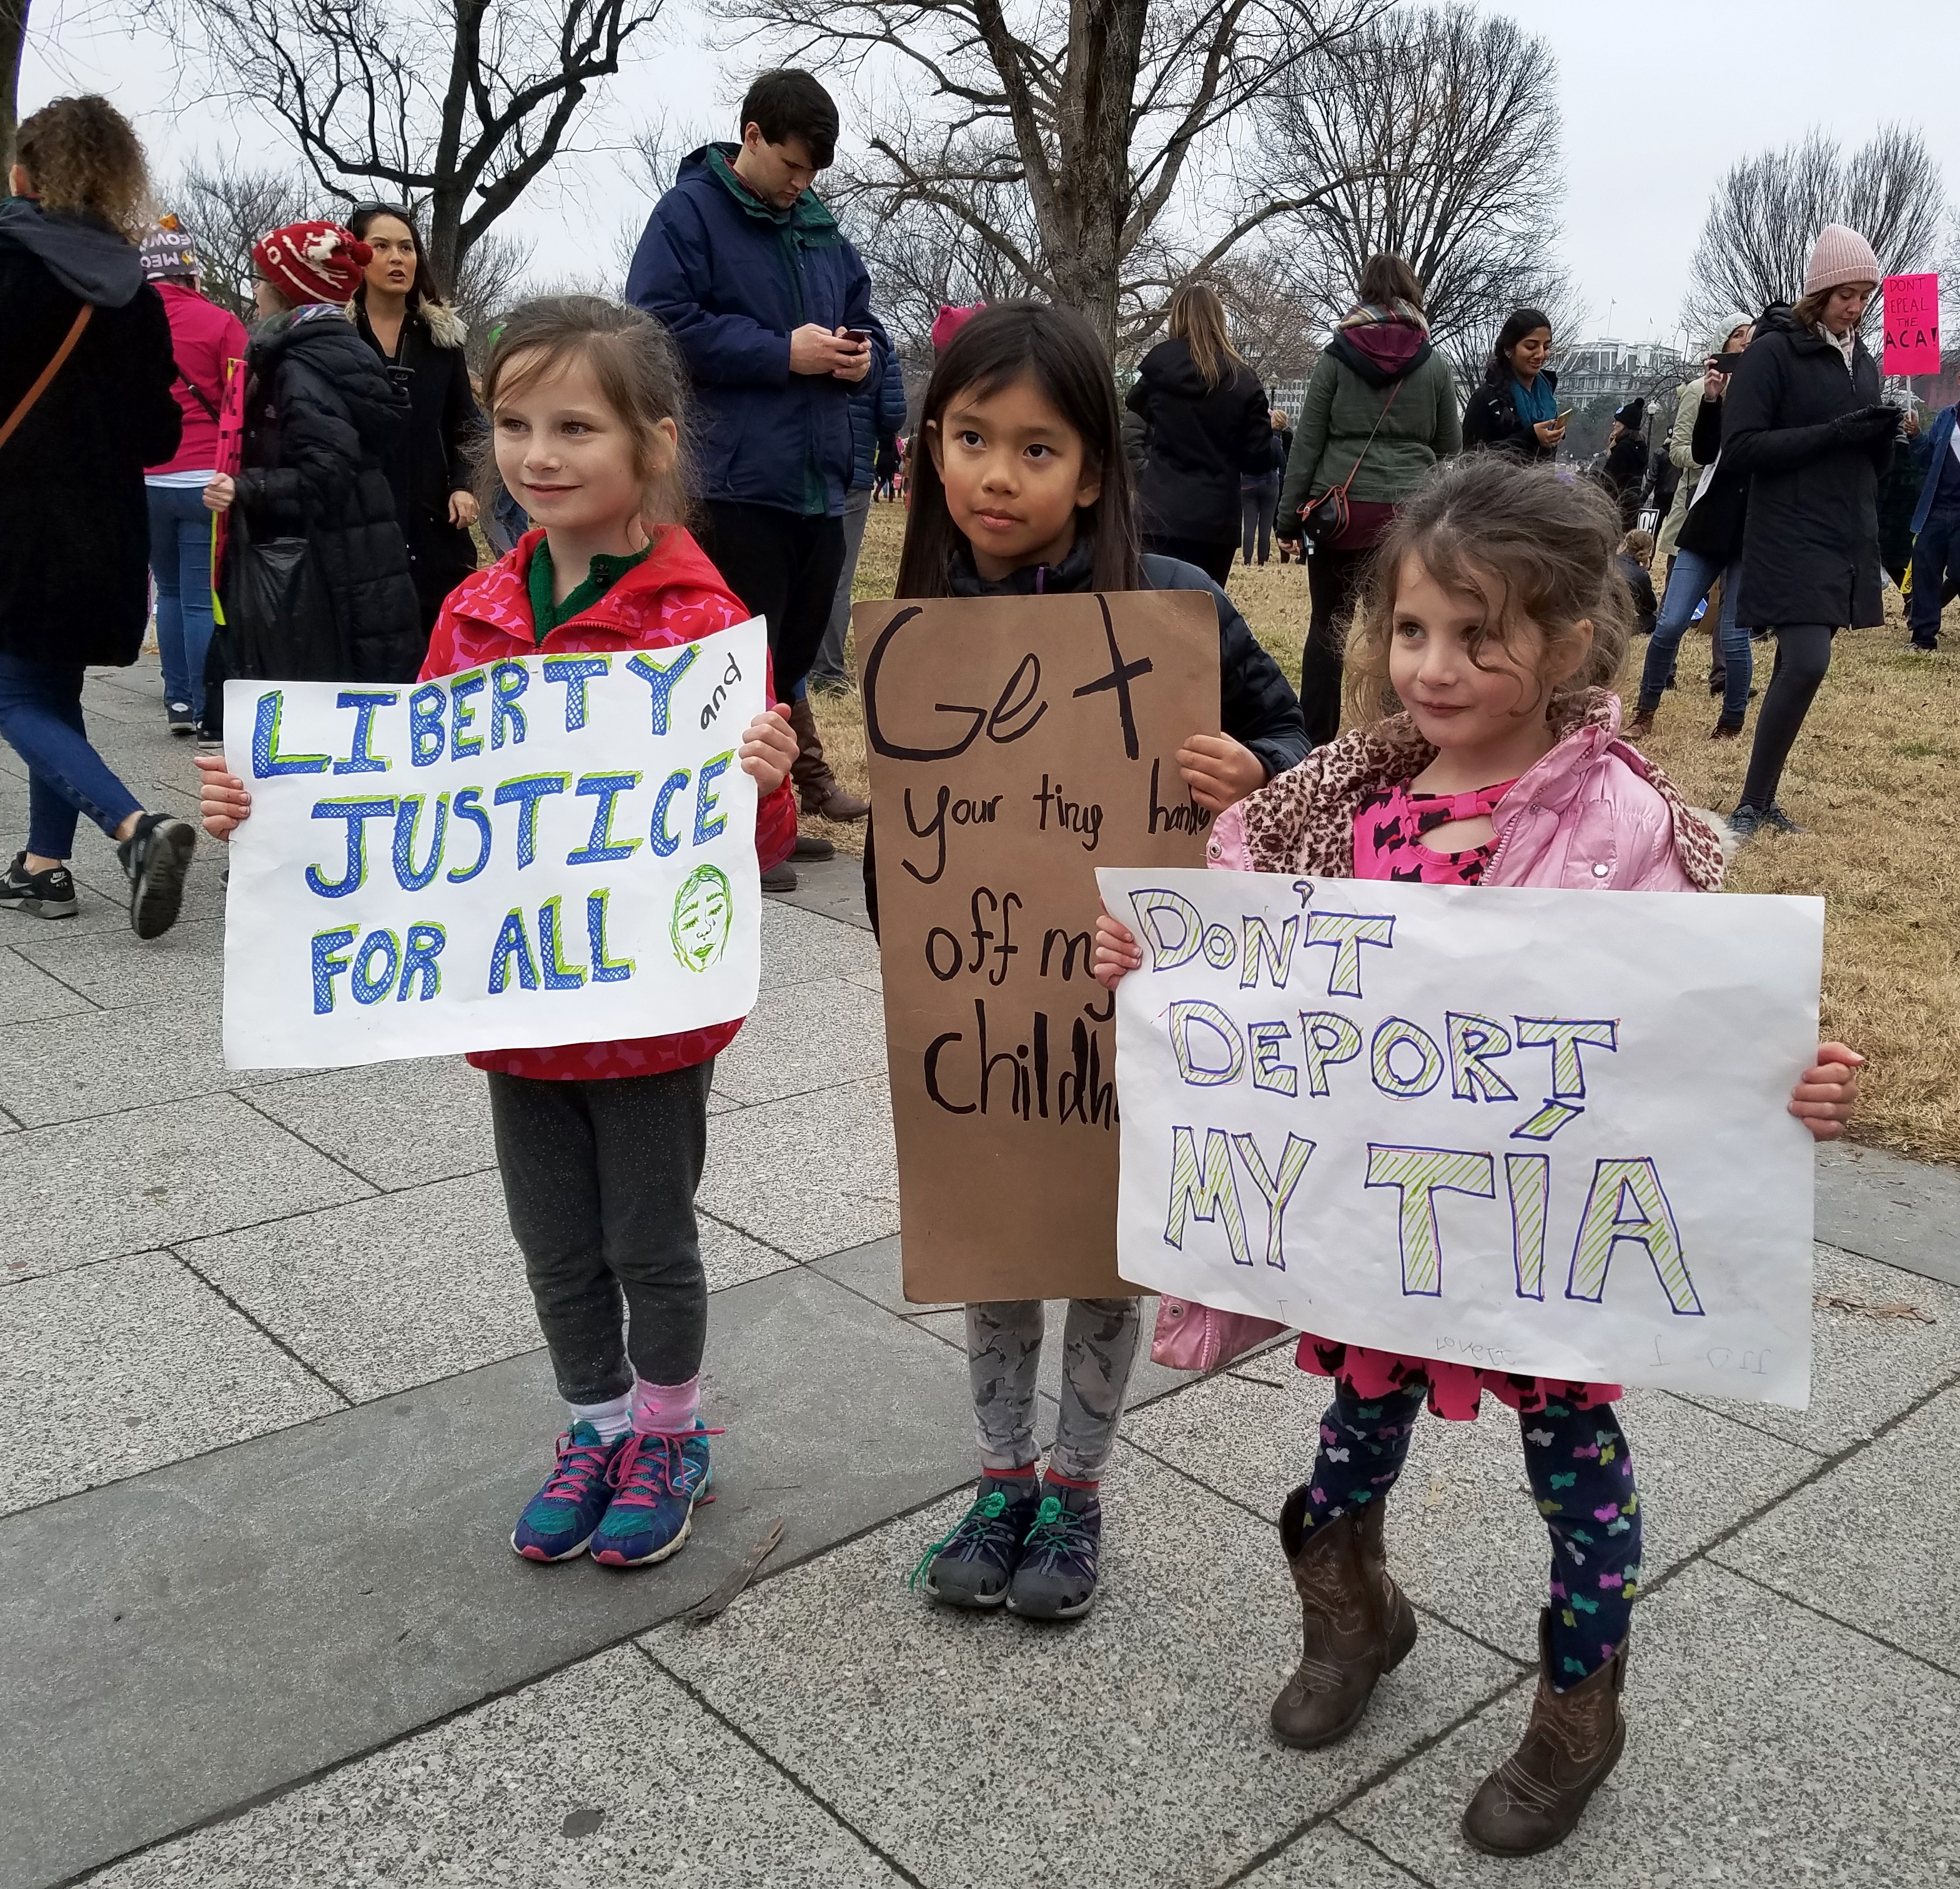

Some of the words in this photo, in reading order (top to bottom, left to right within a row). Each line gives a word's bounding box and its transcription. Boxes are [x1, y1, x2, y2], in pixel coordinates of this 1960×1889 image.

[140, 251, 180, 268] MEO
[260, 230, 282, 265] LO
[1889, 277, 1926, 293] DON'T
[1884, 297, 1929, 314] REPEAL
[1885, 327, 1938, 349] ACA!
[1896, 317, 1919, 328] THE
[1637, 512, 1656, 533] O!
[250, 643, 705, 779] LIBERTY
[700, 653, 742, 730] and
[863, 593, 1153, 762] Get
[305, 748, 737, 898] JUSTICE
[901, 785, 1003, 884] your
[311, 921, 448, 1015] FOR
[487, 887, 636, 994] ALL
[925, 886, 1022, 986] off
[924, 999, 1119, 1131] Childh
[1169, 999, 1620, 1103] DEPORT
[1163, 1126, 1317, 1272] MY
[1364, 1098, 1706, 1317] TÍA
